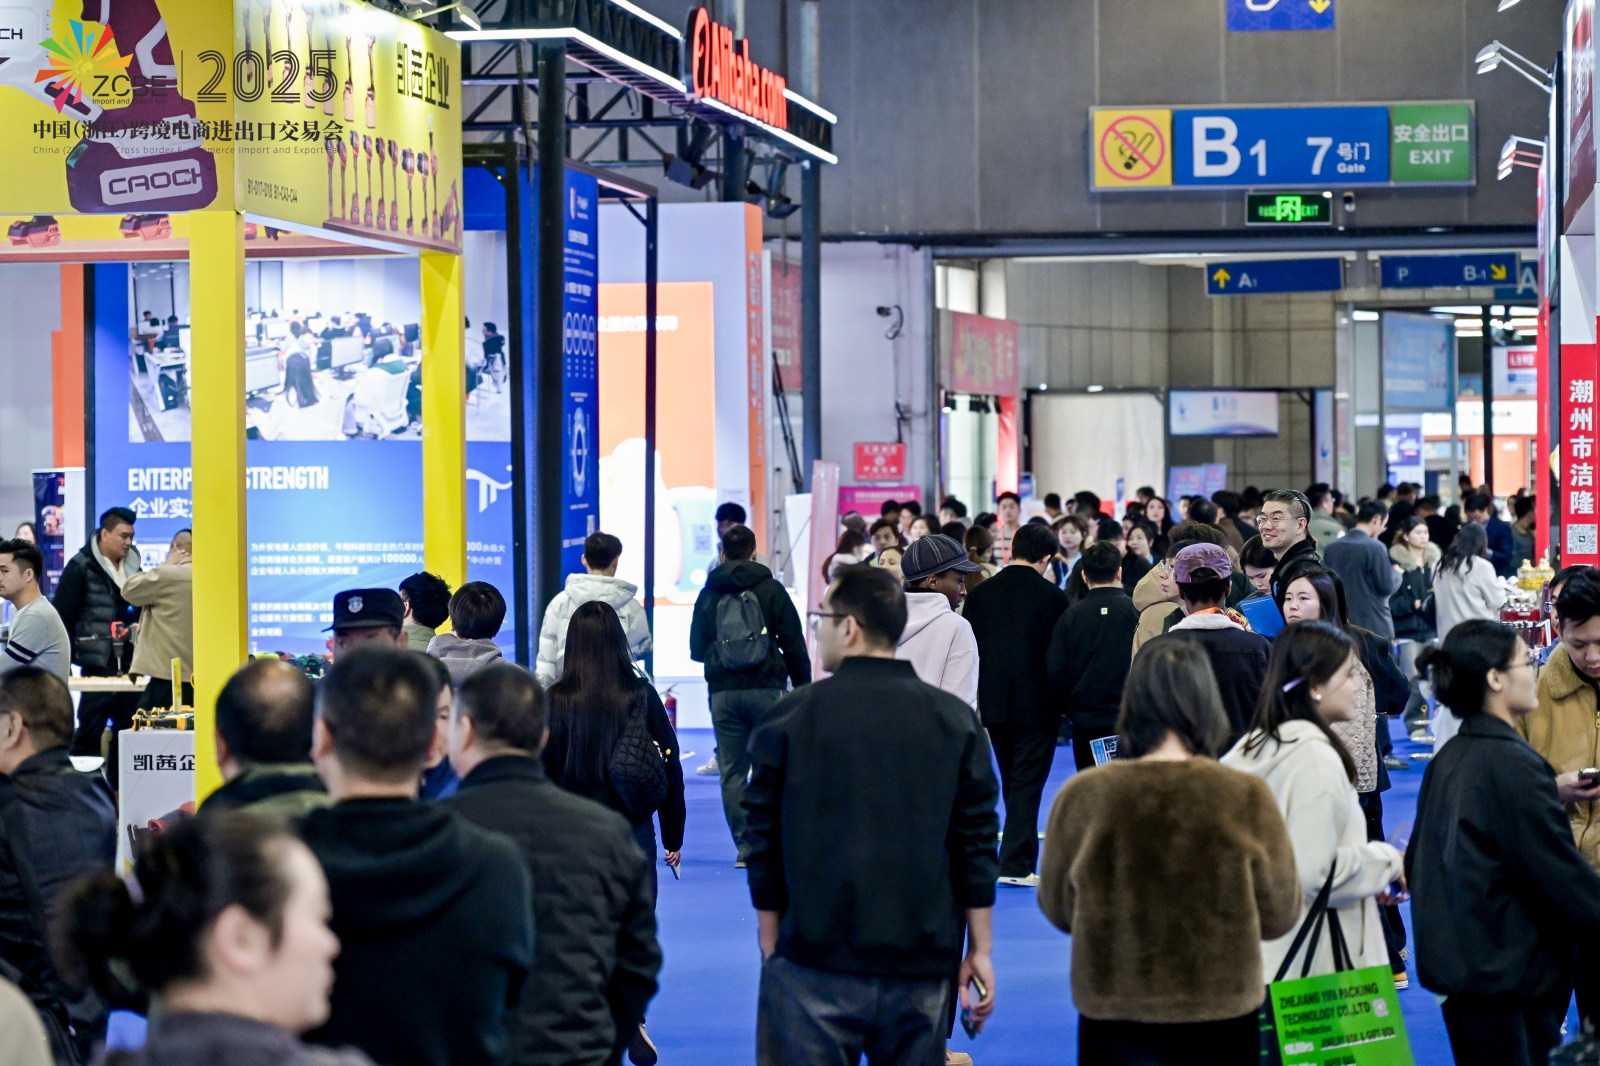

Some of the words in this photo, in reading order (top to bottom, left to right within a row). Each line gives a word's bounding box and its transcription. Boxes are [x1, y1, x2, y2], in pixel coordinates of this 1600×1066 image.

[1394, 124, 1469, 143] 安全出口
[1306, 137, 1334, 176] 7
[1337, 142, 1371, 161] 号门
[1409, 149, 1455, 165] EXIT
[1336, 162, 1366, 174] Gate
[1397, 267, 1409, 283] P
[1569, 379, 1594, 515] 潮州市洁隆
[129, 497, 193, 519] 企业实
